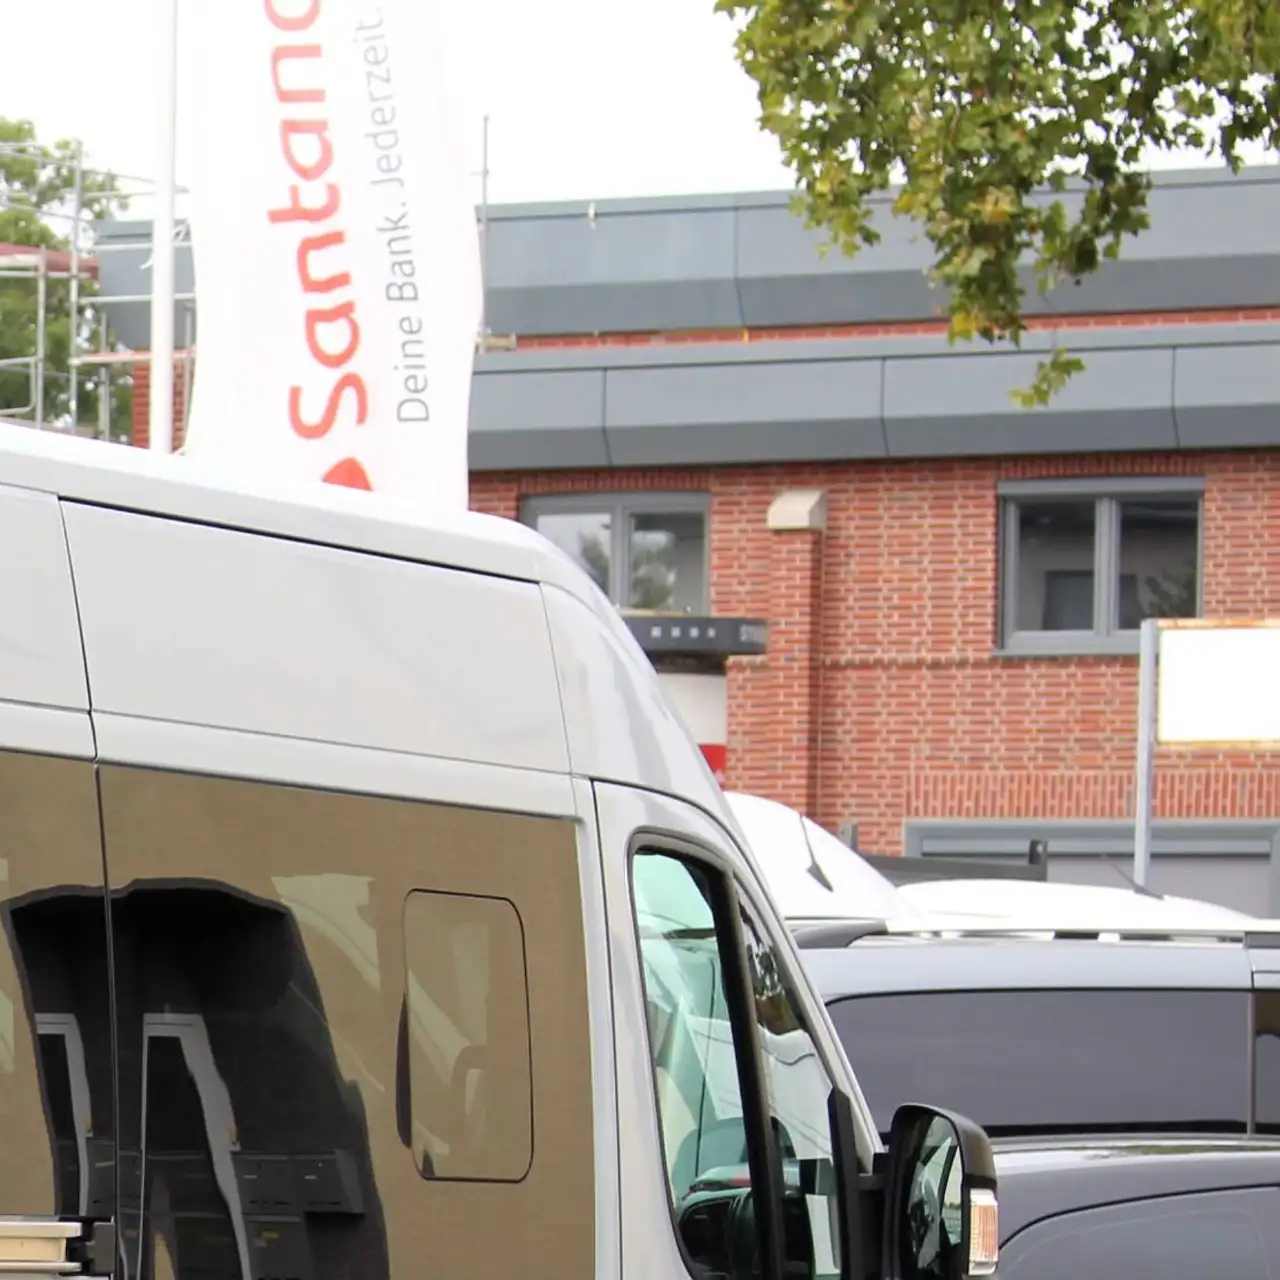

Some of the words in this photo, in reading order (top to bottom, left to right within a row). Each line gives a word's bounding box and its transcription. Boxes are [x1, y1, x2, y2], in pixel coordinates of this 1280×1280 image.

[353, 6, 405, 190] Jederzeit.
[377, 201, 419, 302] Bank.
[394, 316, 430, 423] Deine
